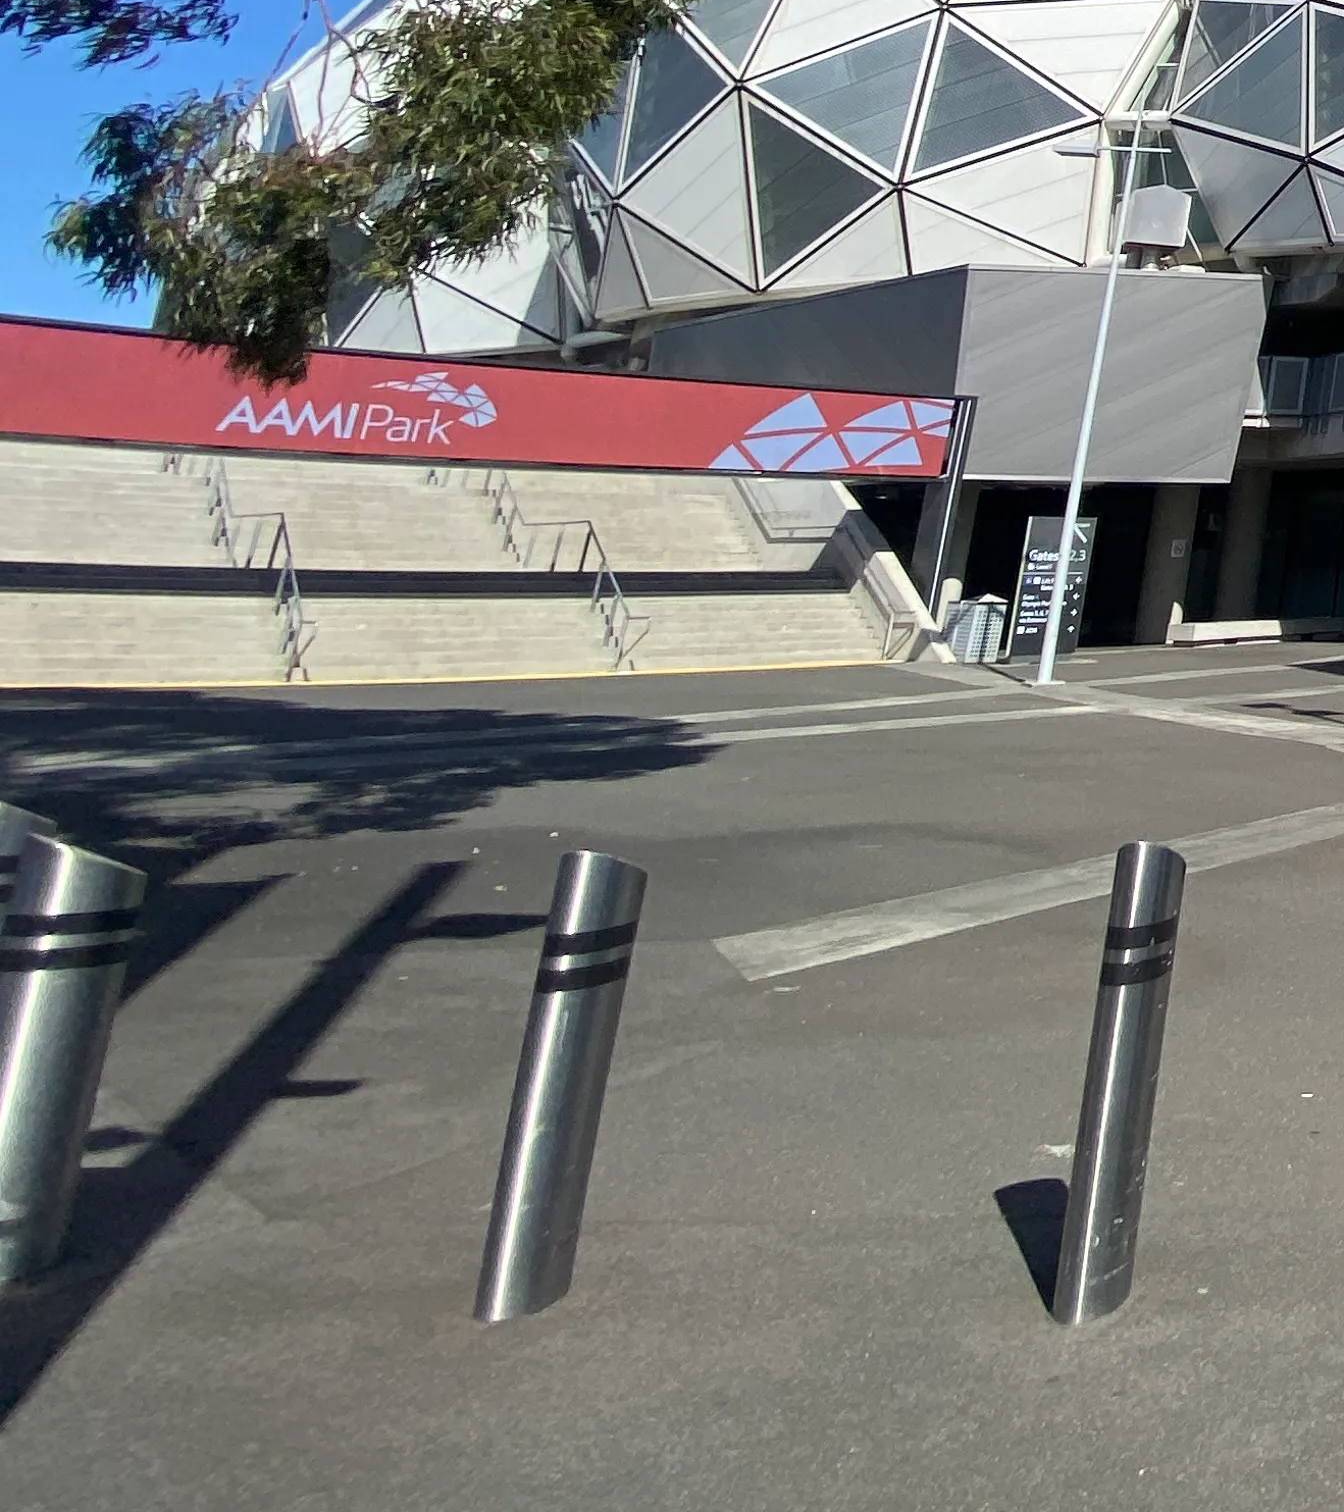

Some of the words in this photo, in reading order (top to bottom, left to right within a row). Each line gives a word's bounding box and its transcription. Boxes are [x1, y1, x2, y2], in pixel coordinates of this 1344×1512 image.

[215, 395, 360, 439] AAMI
[360, 403, 454, 445] Park
[1029, 549, 1059, 561] Gates
